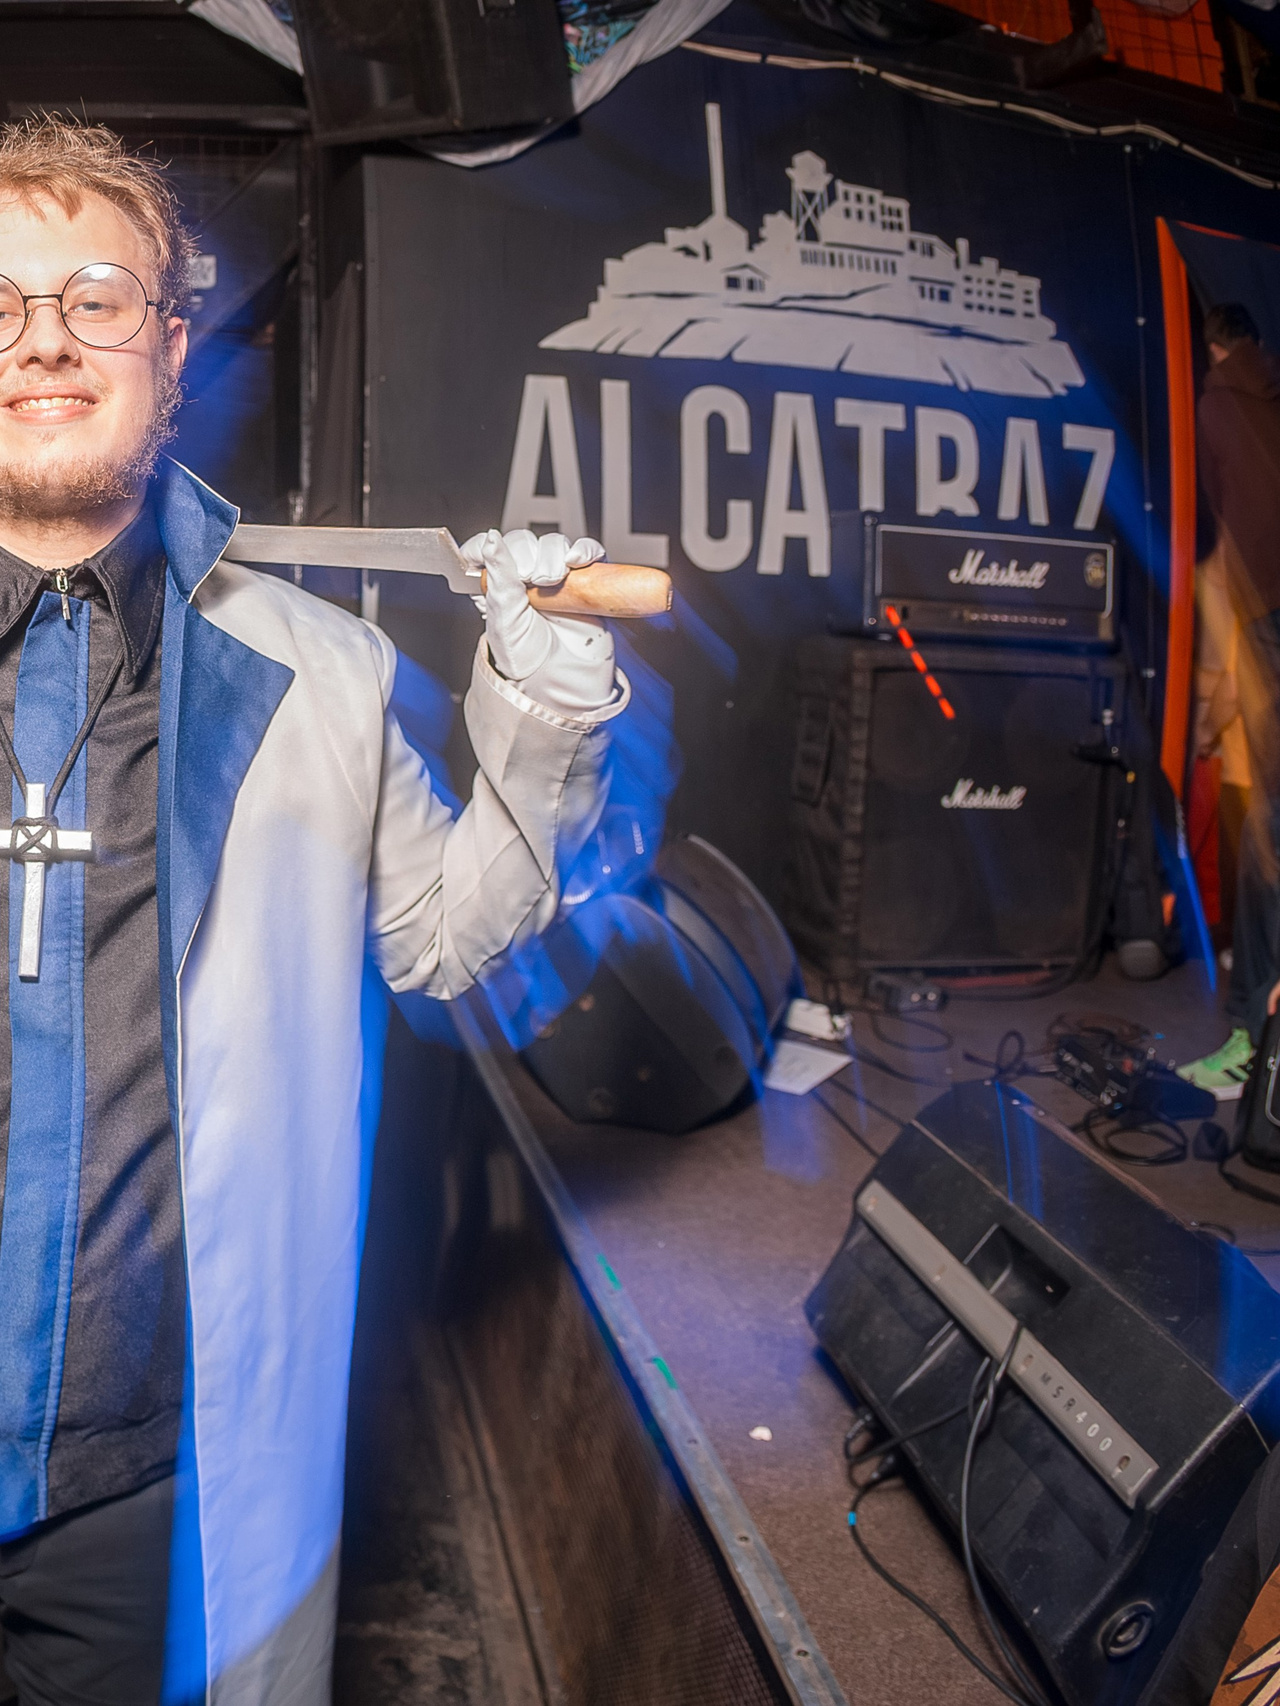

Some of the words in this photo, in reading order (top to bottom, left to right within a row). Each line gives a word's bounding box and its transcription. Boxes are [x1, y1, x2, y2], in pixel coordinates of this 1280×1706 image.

[948, 549, 1051, 589] Marshall
[941, 778, 1027, 810] Marshall
[1040, 1371, 1113, 1452] MSR400
